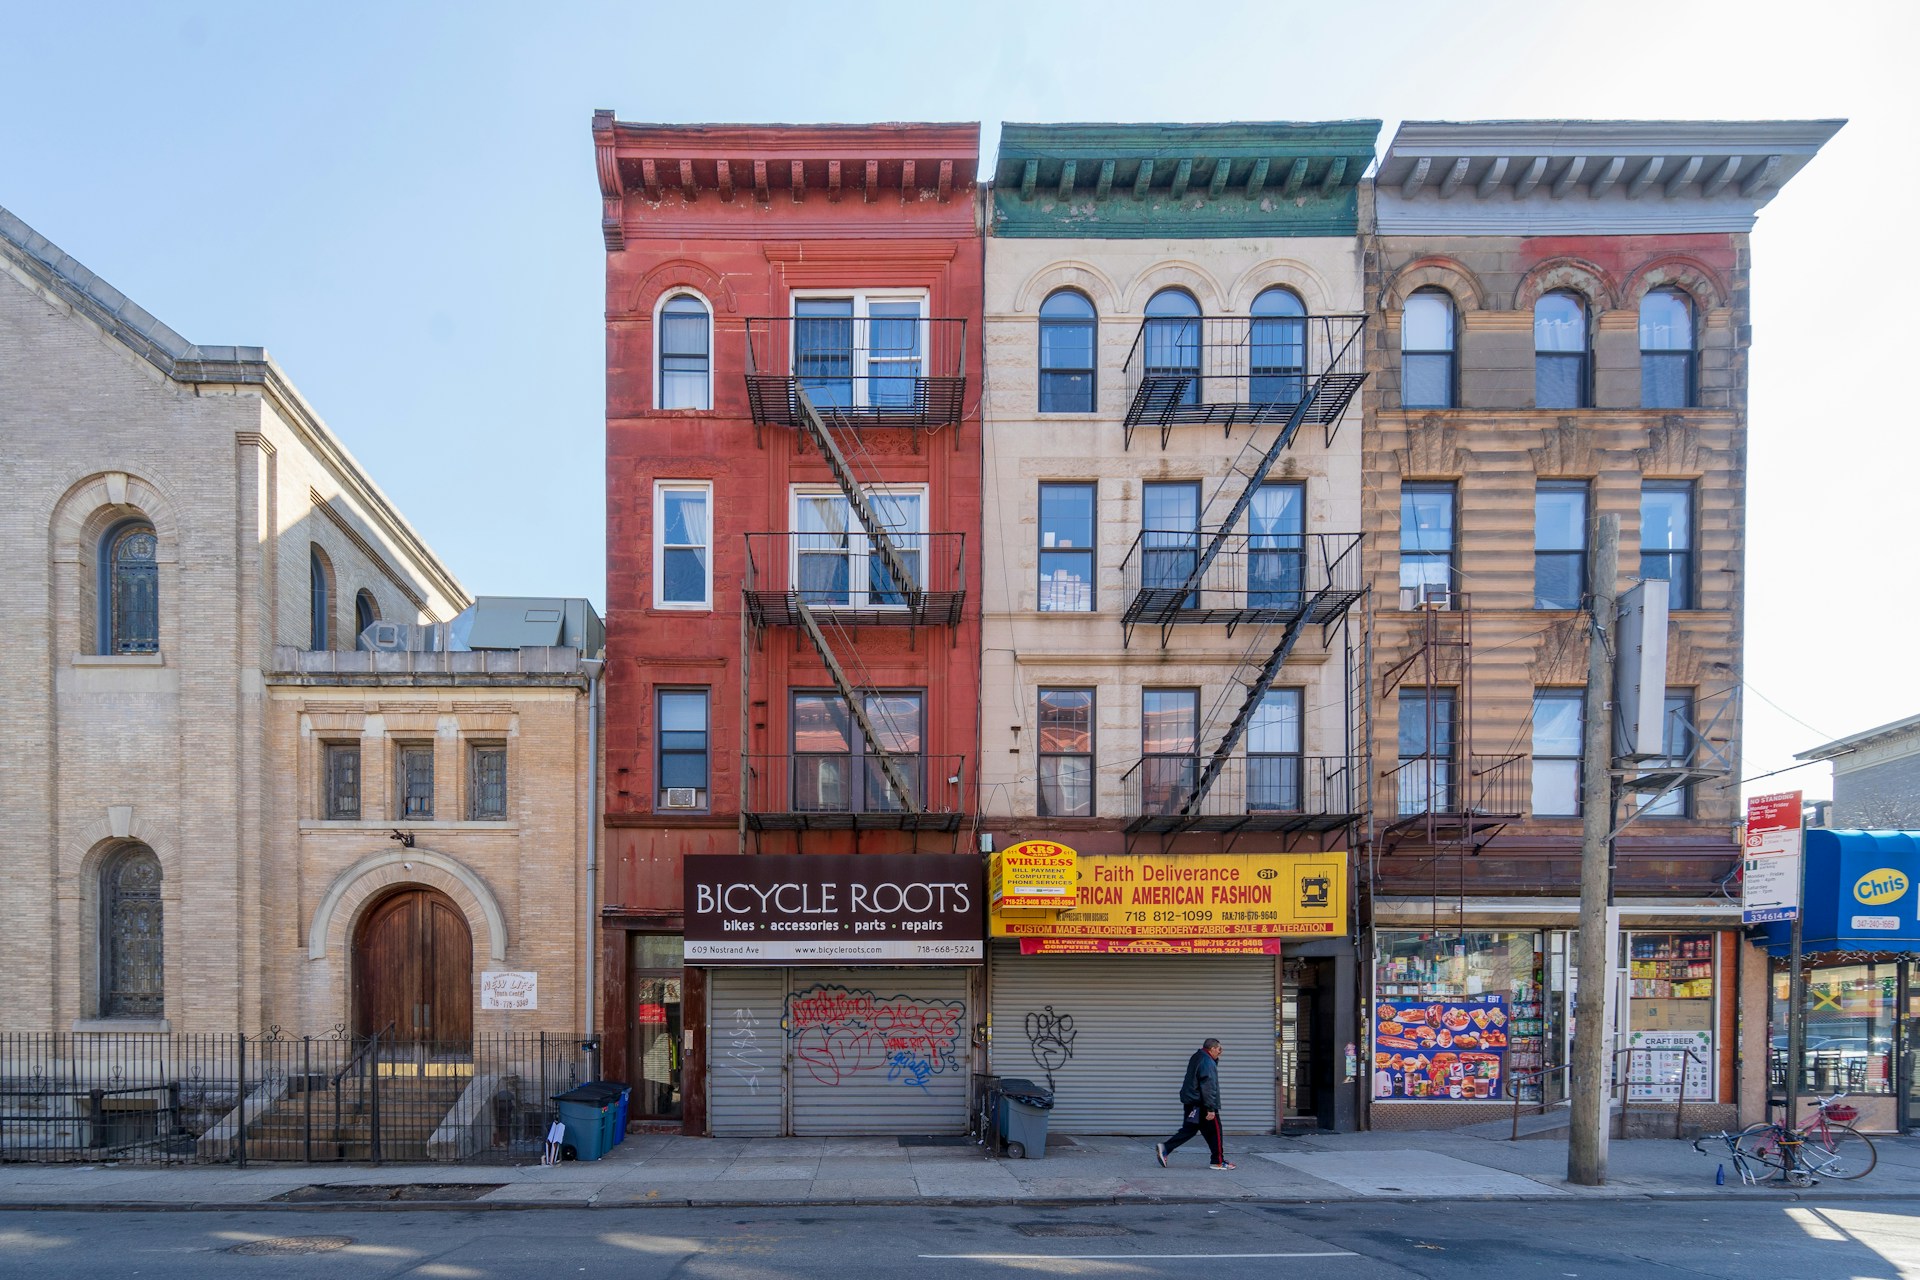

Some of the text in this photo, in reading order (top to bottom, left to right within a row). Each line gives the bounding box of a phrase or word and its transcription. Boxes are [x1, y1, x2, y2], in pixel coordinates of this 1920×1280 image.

[1760, 793, 1794, 803] STANDING
[1026, 845, 1056, 855] KRS
[1007, 858, 1074, 867] WIRELESS
[1094, 864, 1240, 882] Faith Deliverance
[1260, 870, 1276, 879] 611
[1857, 875, 1905, 899] Chris
[696, 883, 839, 914] BICYCLE
[850, 883, 971, 914] ROOTS
[1132, 885, 1204, 905] AMERICAN
[1212, 884, 1272, 904] FASHION
[1125, 910, 1213, 922] 718 812-1099
[1751, 913, 1782, 921] 334614
[723, 919, 943, 935] bikes accessories parts repairs
[1013, 923, 1327, 934] CUSTOM MADE TAILORING EMBROIDERY FABRIC SALE & ALTERATION
[691, 945, 760, 955] 609 Nostrand Ave
[794, 945, 883, 956] www.bicycleroots.com
[917, 945, 976, 955] 718-668-5224
[484, 981, 535, 991] NEW LIFE
[1487, 995, 1501, 1003] EBT
